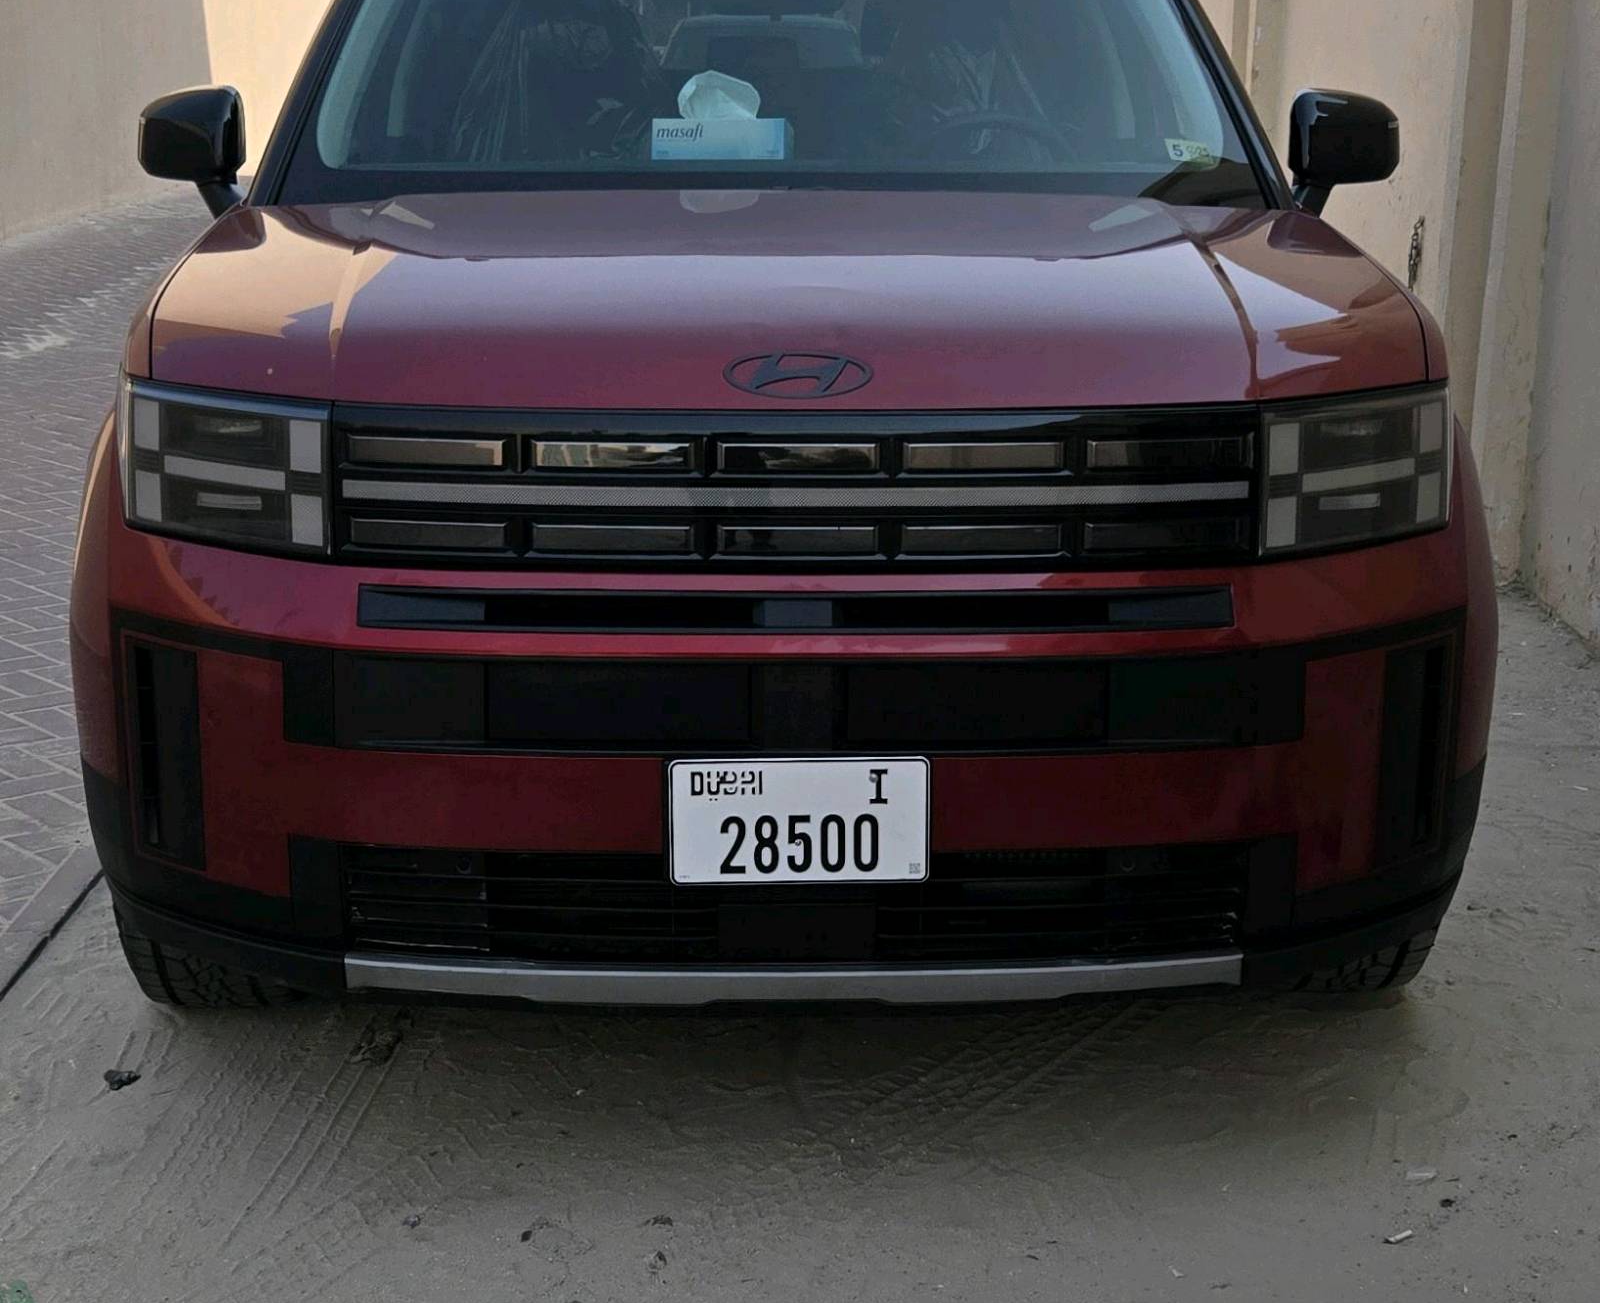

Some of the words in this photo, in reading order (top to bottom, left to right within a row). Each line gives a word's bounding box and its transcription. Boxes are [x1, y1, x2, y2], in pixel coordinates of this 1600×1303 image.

[656, 123, 704, 142] masafi
[1172, 144, 1184, 157] 5
[869, 768, 888, 804] I
[720, 813, 879, 875] 28500
